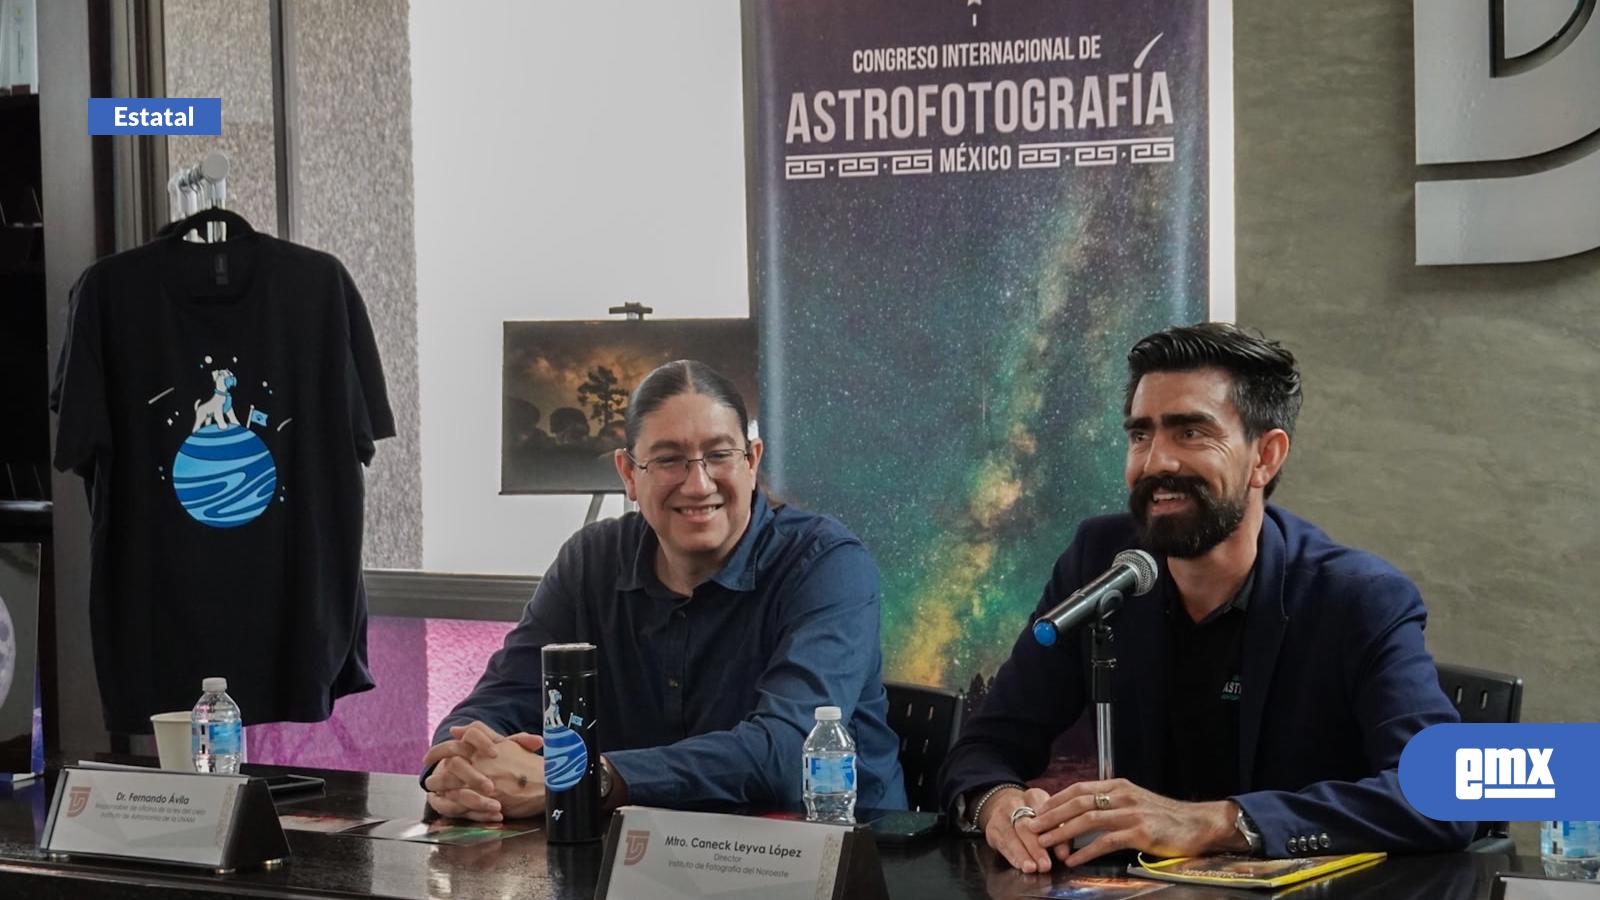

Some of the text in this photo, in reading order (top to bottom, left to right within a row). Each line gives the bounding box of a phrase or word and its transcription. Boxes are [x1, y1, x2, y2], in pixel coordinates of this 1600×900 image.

[852, 35, 1101, 73] CONGRESO INTERNACIONAL DE
[785, 32, 1174, 144] ASTROFOTOGRAFÍA
[940, 142, 1011, 173] MÉXICO
[1222, 681, 1242, 695] AST
[116, 791, 190, 805] Dr. Fernando Ávila
[665, 836, 802, 858] Mtro. Caneck Leyva López
[714, 853, 742, 863] Director
[695, 861, 704, 870] de
[743, 866, 754, 875] del
[756, 867, 789, 878] Noroeste
